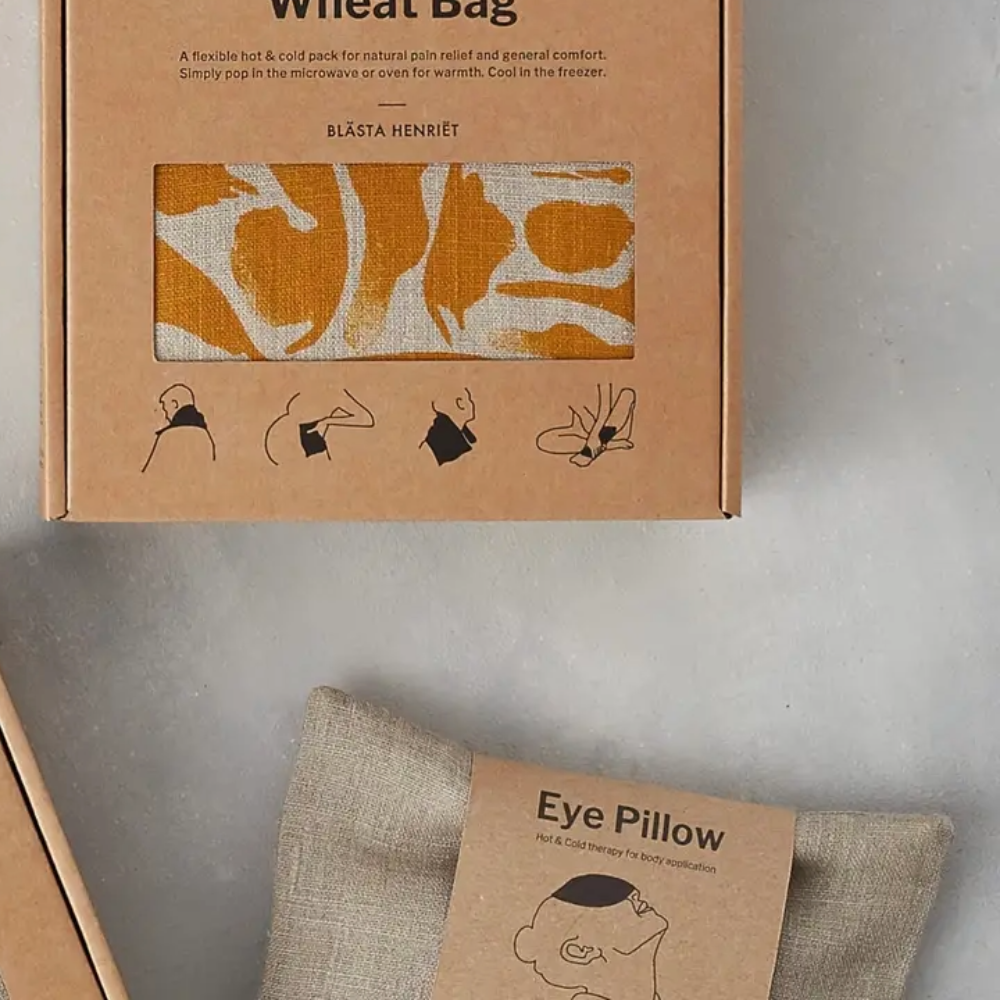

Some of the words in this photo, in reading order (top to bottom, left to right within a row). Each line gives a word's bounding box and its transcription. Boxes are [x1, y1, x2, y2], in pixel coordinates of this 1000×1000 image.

[179, 51, 188, 61] A
[192, 50, 237, 61] flexible
[241, 51, 261, 61] hot
[265, 50, 275, 61] &
[279, 50, 304, 61] cold
[309, 50, 338, 62] pack
[342, 50, 360, 61] for
[363, 50, 407, 60] natural
[411, 50, 436, 62] pain
[440, 50, 472, 60] relief
[476, 50, 498, 60] and
[502, 49, 549, 62] general
[552, 49, 606, 60] comfort.
[180, 68, 221, 80] Simply
[225, 70, 248, 80] pop
[252, 67, 262, 78] in
[267, 68, 286, 78] the
[291, 67, 358, 78] microwave
[362, 69, 374, 78] or
[378, 69, 408, 78] oven
[412, 67, 430, 77] for
[434, 66, 484, 77] warmth.
[488, 66, 516, 77] Cool
[519, 66, 530, 77] in
[534, 67, 554, 77] the
[558, 66, 606, 77] freezer.
[328, 121, 385, 137] BLÄSTA
[392, 121, 458, 136] HENRIËT
[537, 790, 604, 829] Eye
[615, 805, 724, 851] Pillow
[536, 833, 553, 843] Hot
[554, 836, 561, 845] &
[565, 837, 586, 849] Cold
[588, 842, 623, 857] therapy
[626, 849, 638, 858] for
[640, 852, 664, 865] body
[665, 859, 716, 873] application
